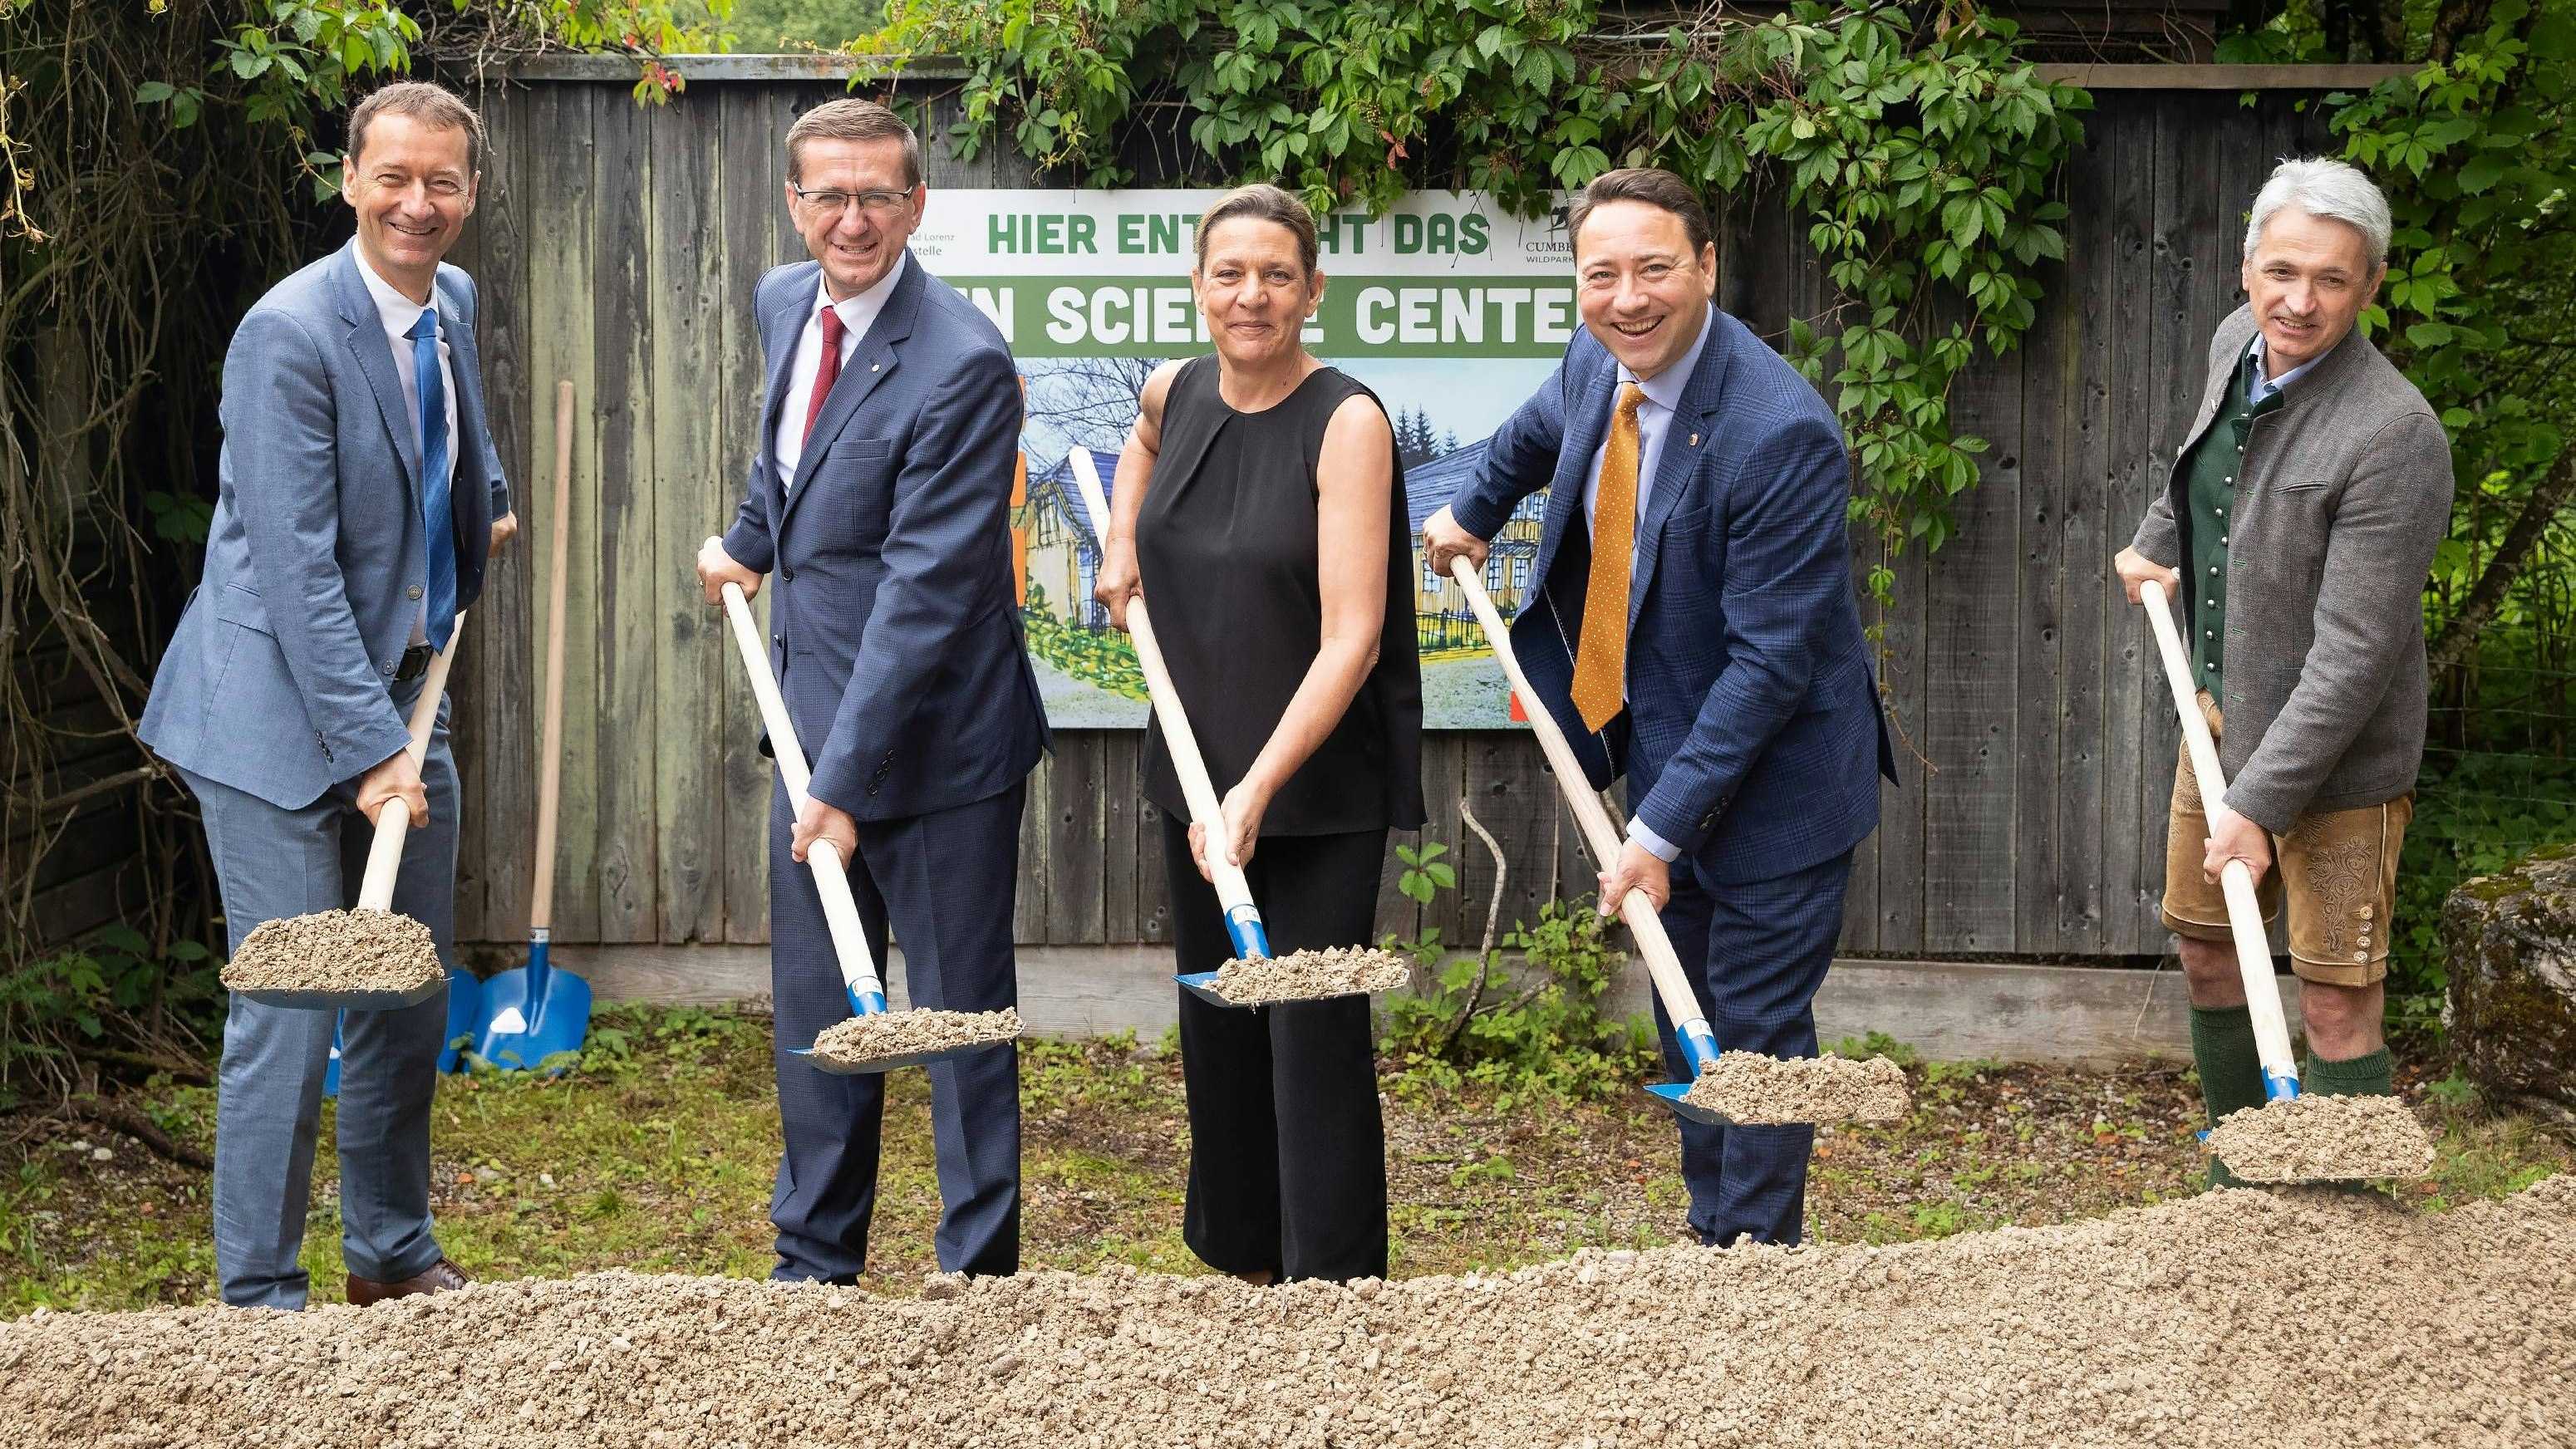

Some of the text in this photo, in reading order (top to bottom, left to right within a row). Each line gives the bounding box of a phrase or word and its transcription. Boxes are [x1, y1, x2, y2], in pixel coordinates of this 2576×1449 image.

[913, 245, 942, 256] stelle
[988, 213, 1490, 254] HIER ENTHT DAS
[1355, 287, 1583, 344] CENTE
